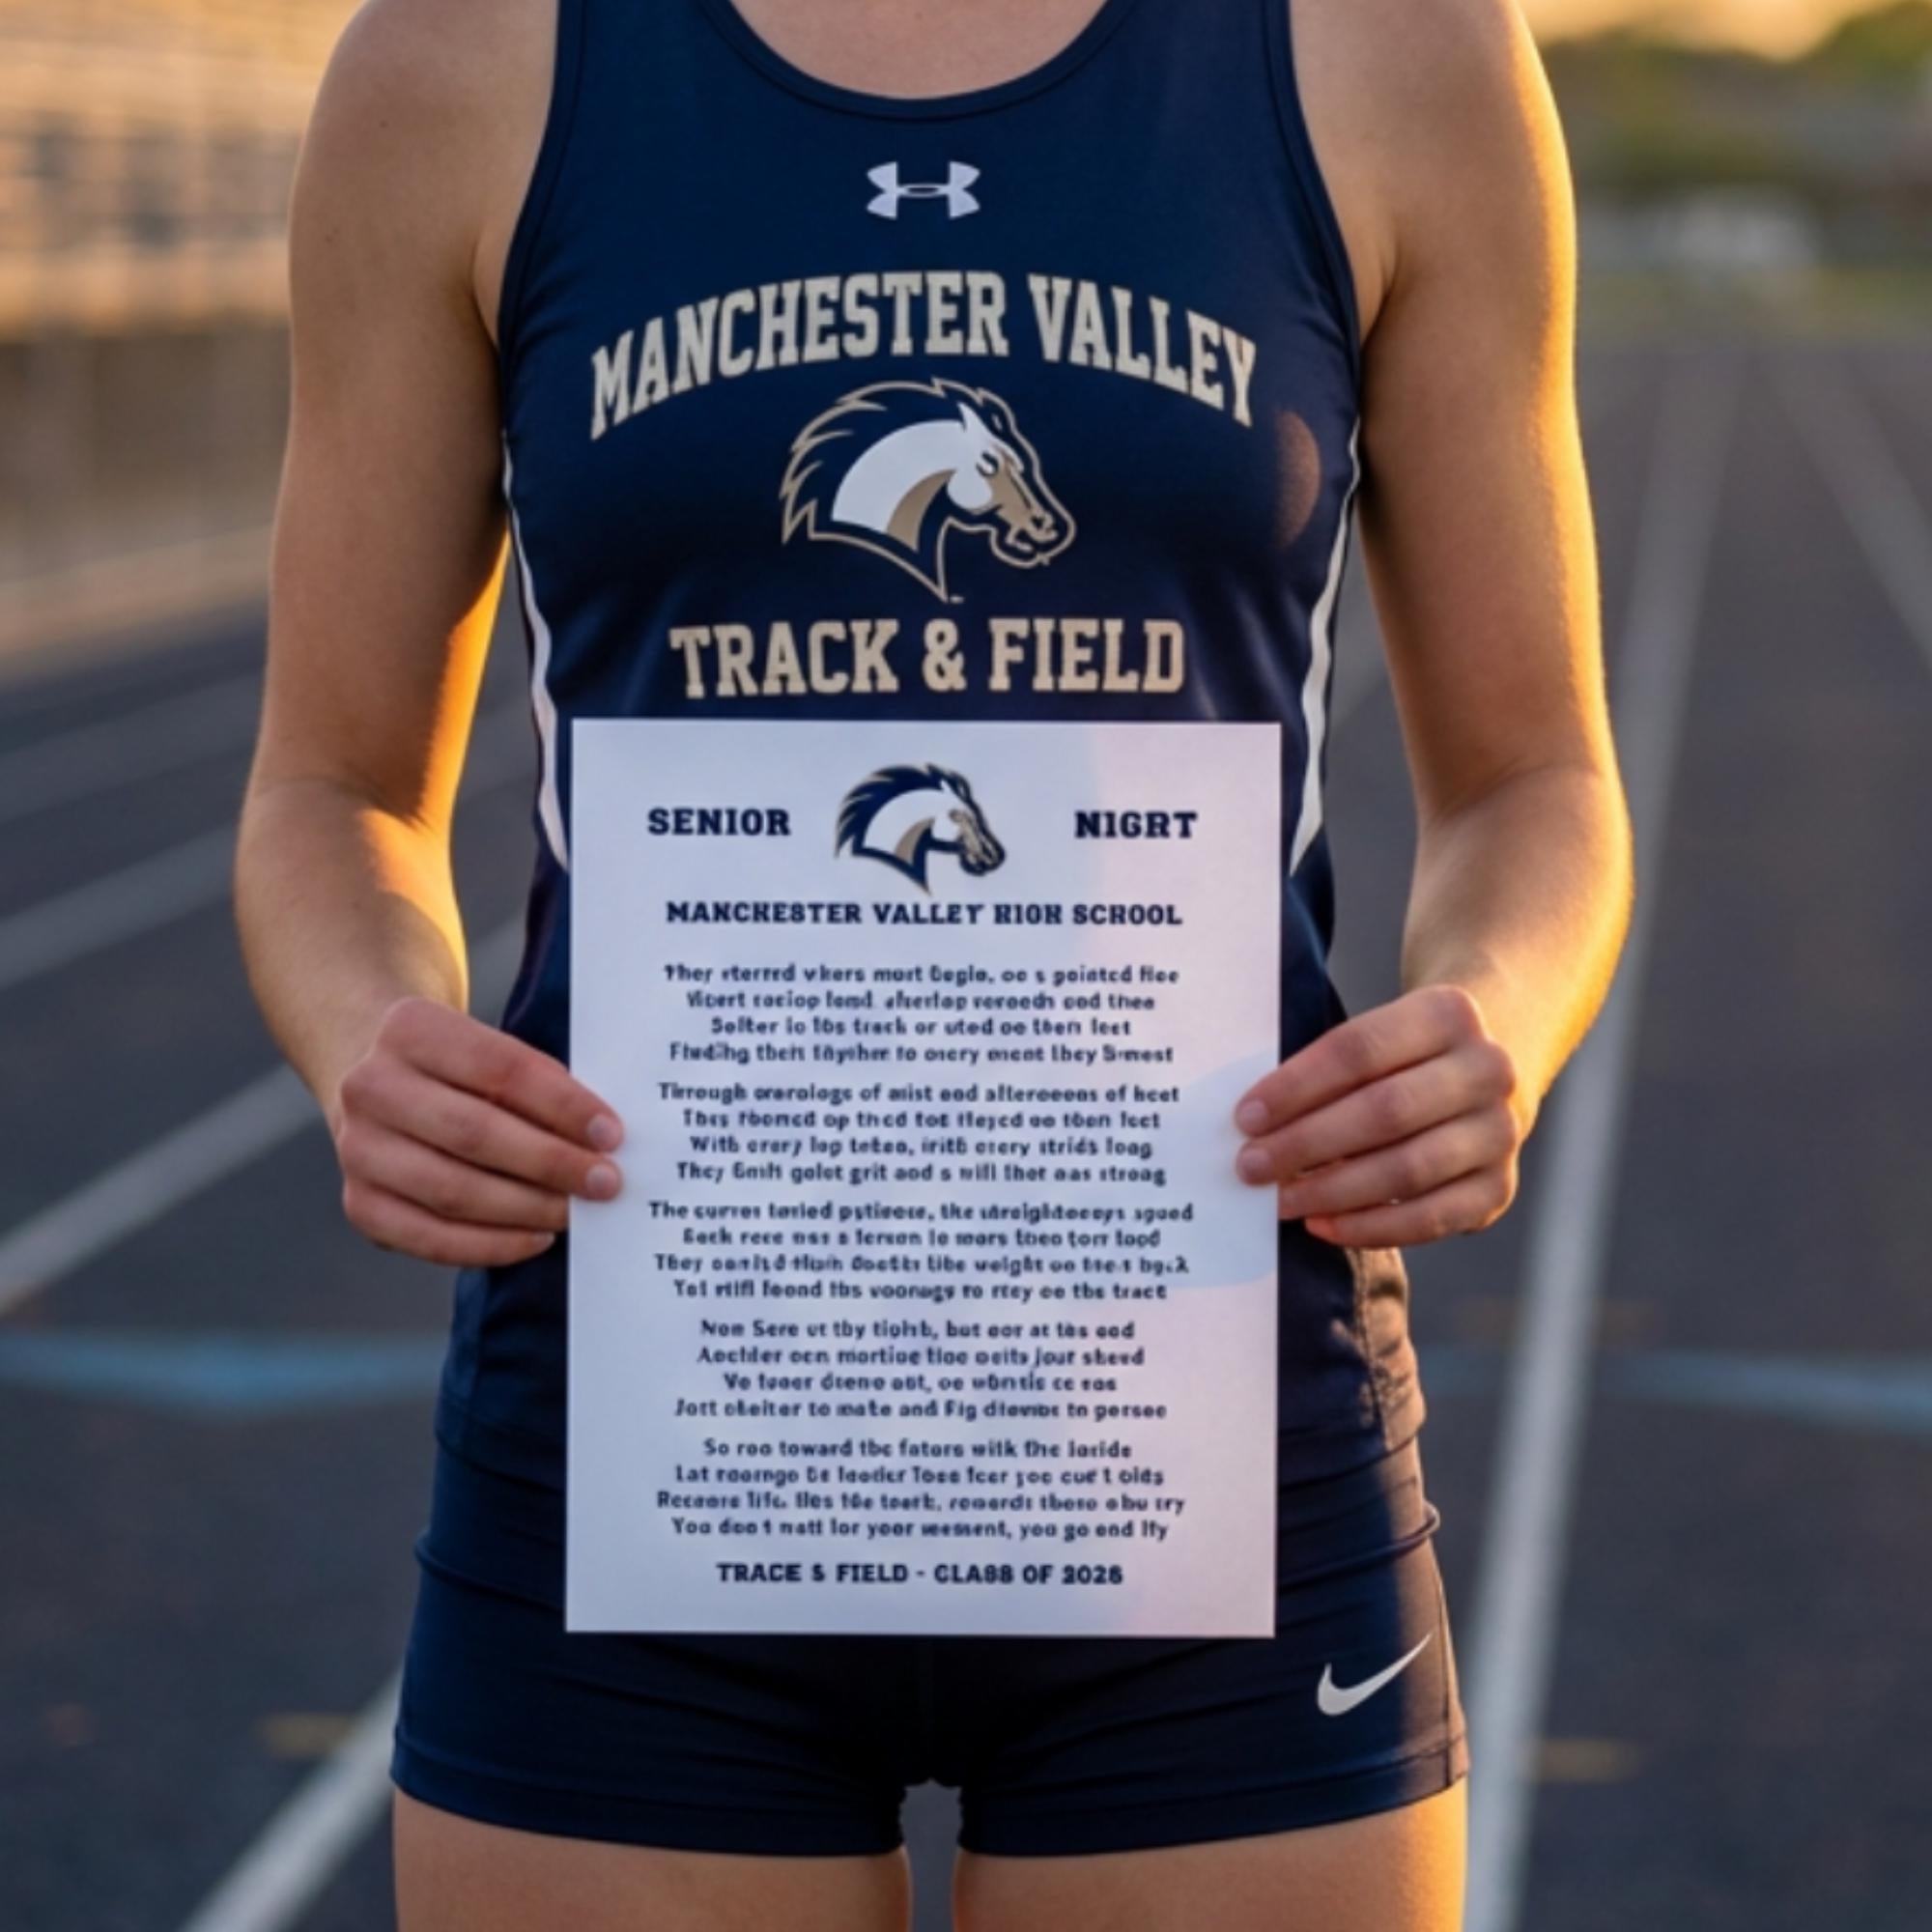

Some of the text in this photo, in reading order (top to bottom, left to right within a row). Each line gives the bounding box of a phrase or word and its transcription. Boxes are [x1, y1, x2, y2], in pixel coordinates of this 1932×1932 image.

[590, 270, 1256, 441] MANCHESTER VALLEY
[668, 618, 1185, 699] TRACK & FIELD
[647, 808, 791, 837] SENIOR
[836, 1562, 909, 1584] FIELD
[1021, 1564, 1054, 1584] OF
